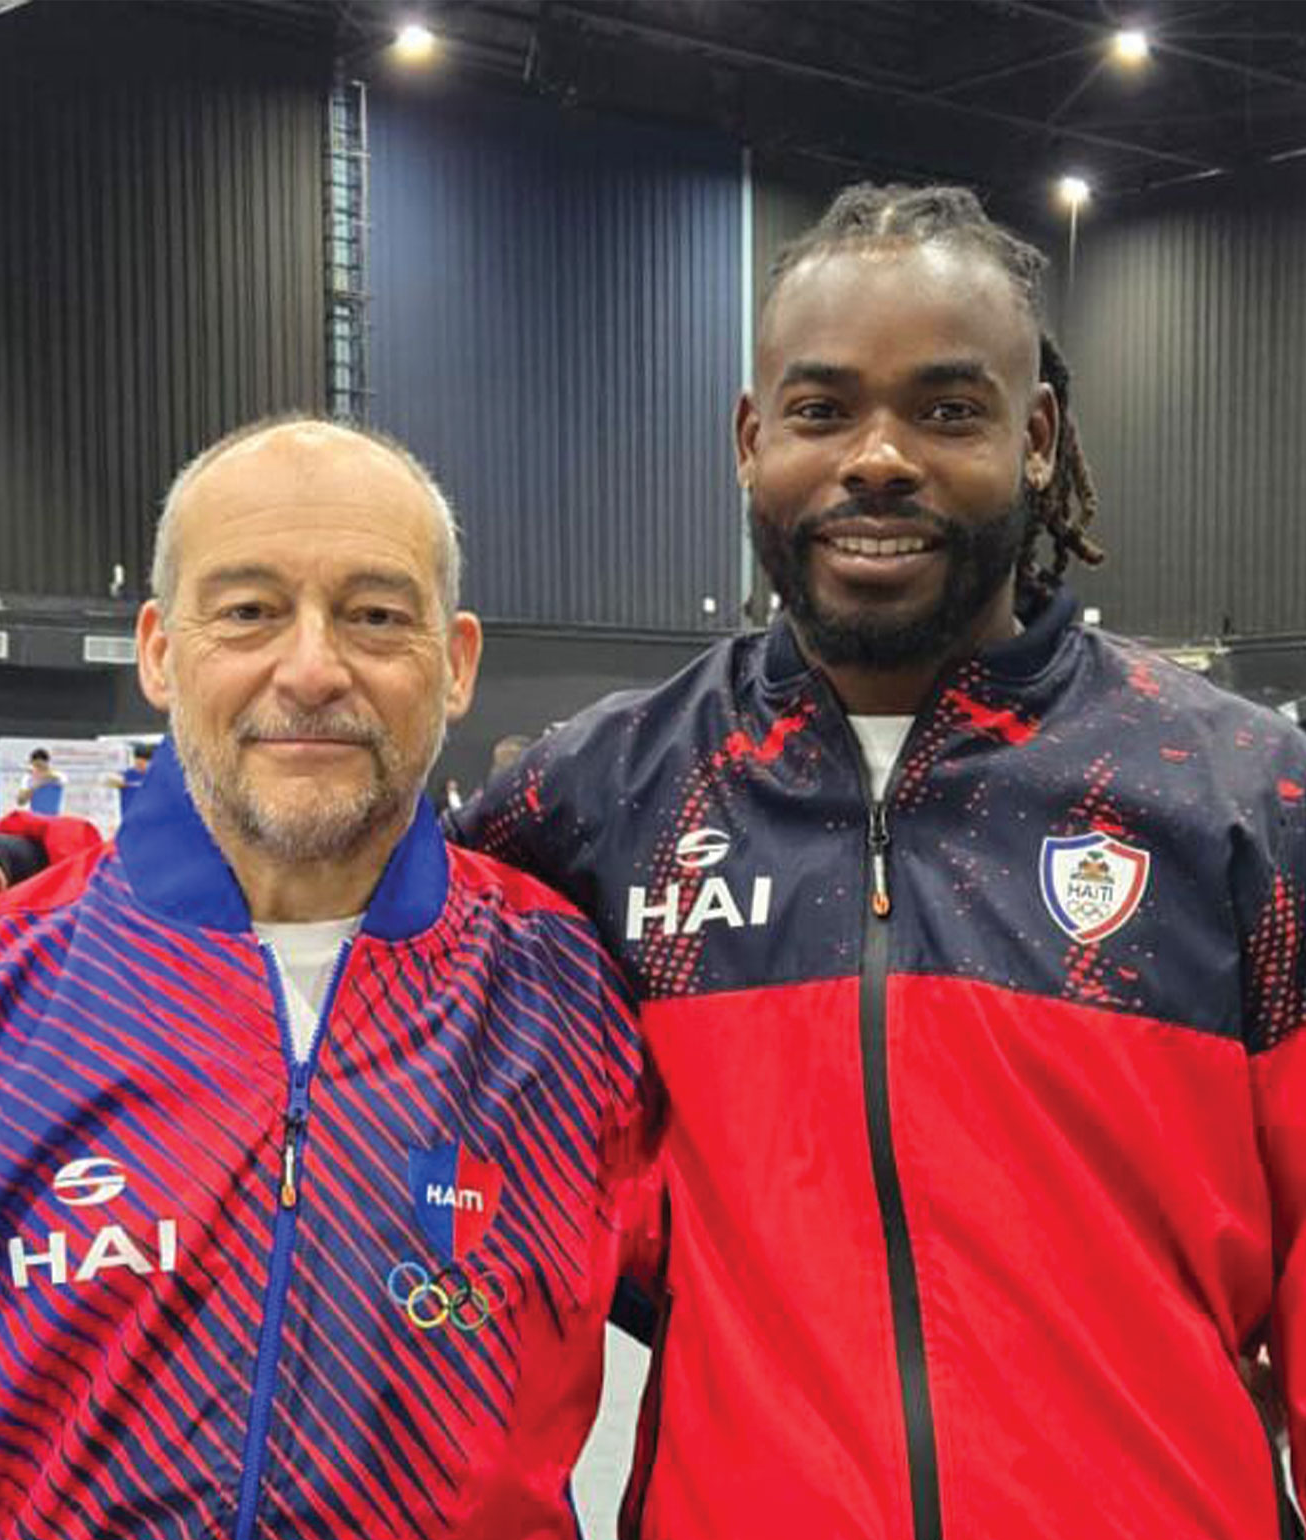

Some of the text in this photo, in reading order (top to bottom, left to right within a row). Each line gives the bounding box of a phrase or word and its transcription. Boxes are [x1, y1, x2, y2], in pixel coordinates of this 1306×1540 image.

[625, 877, 772, 940] HAI
[1067, 882, 1113, 901] HAITI
[426, 1184, 484, 1212] HAITI
[9, 1220, 176, 1287] HAI
